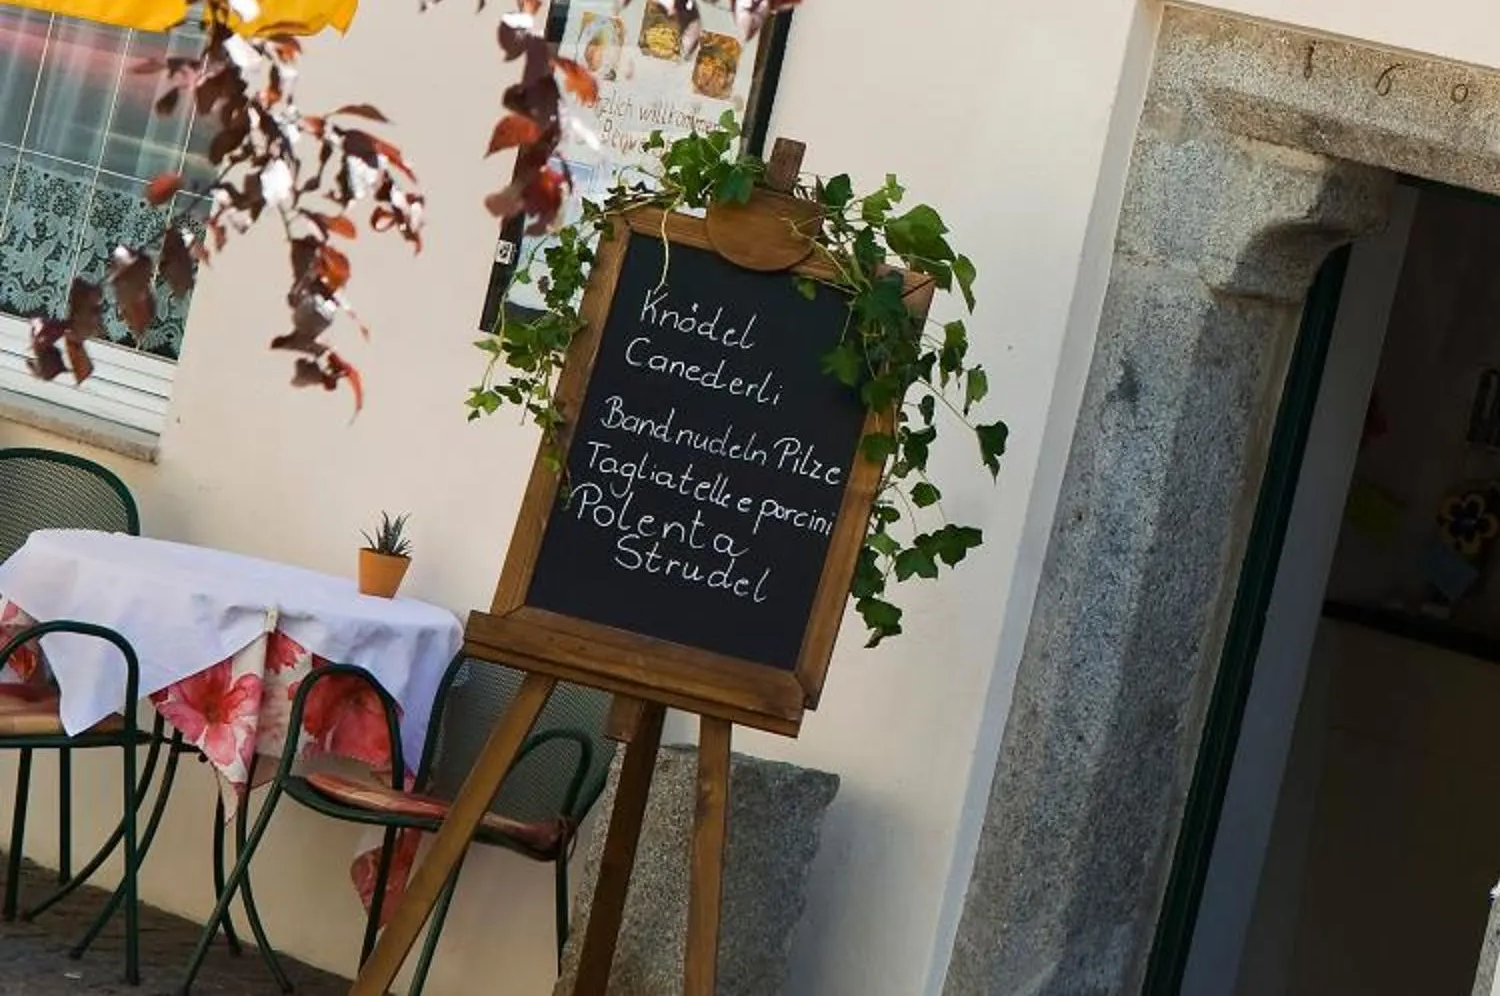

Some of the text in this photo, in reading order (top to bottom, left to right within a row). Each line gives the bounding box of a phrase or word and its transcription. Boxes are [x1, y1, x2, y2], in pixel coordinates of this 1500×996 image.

[625, 337, 784, 406] Canederli
[601, 395, 842, 485] Bandnudeln Pilze
[570, 482, 750, 557] Polenta
[587, 441, 836, 537] Tagliatelle e porcini
[614, 533, 771, 603] Strudel
